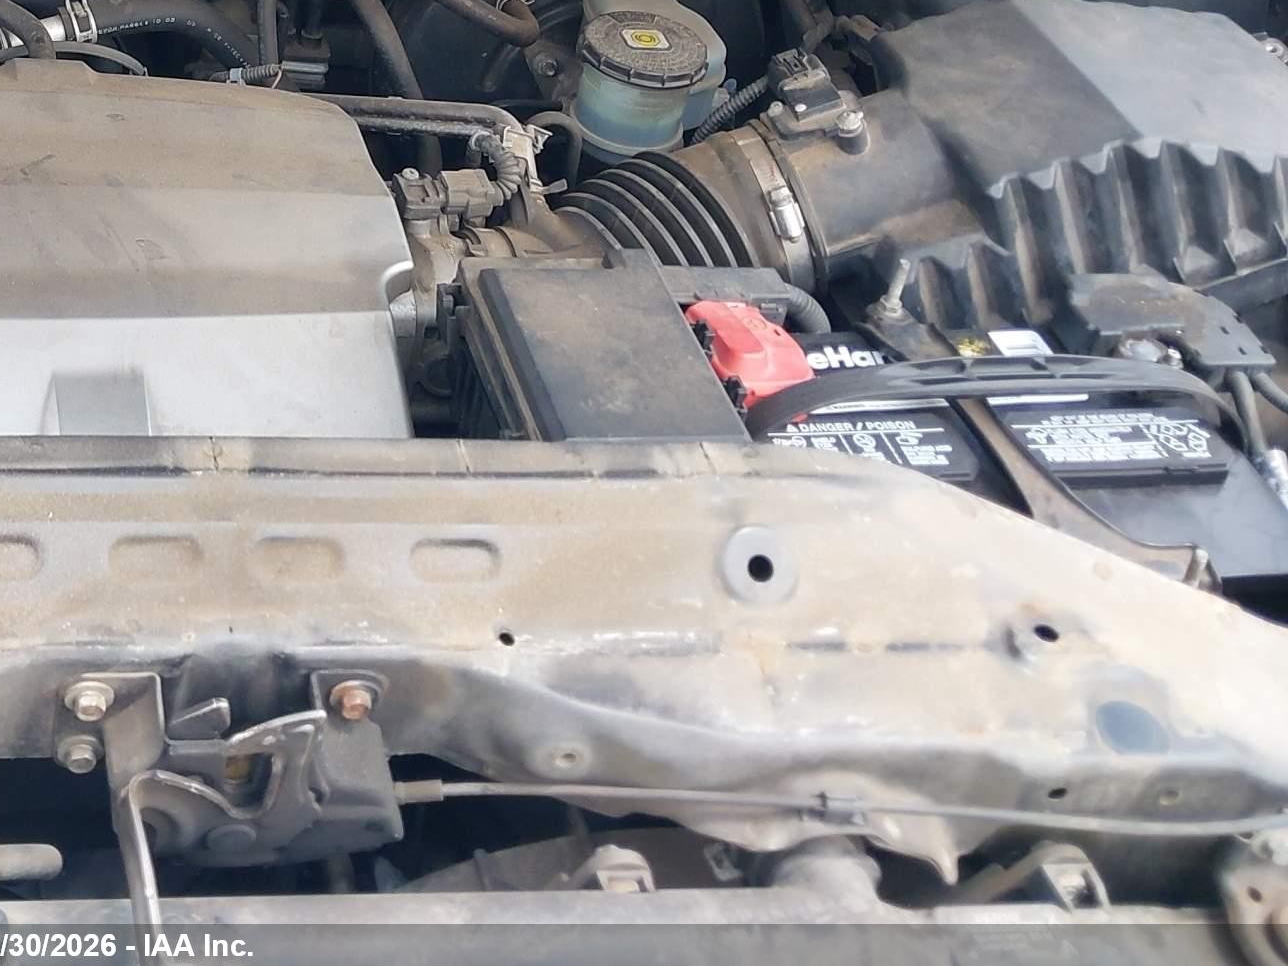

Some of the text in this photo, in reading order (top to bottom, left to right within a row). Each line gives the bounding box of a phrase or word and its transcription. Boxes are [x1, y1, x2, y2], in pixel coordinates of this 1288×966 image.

[806, 346, 885, 370] eHar
[799, 420, 917, 432] DANGER / POISON
